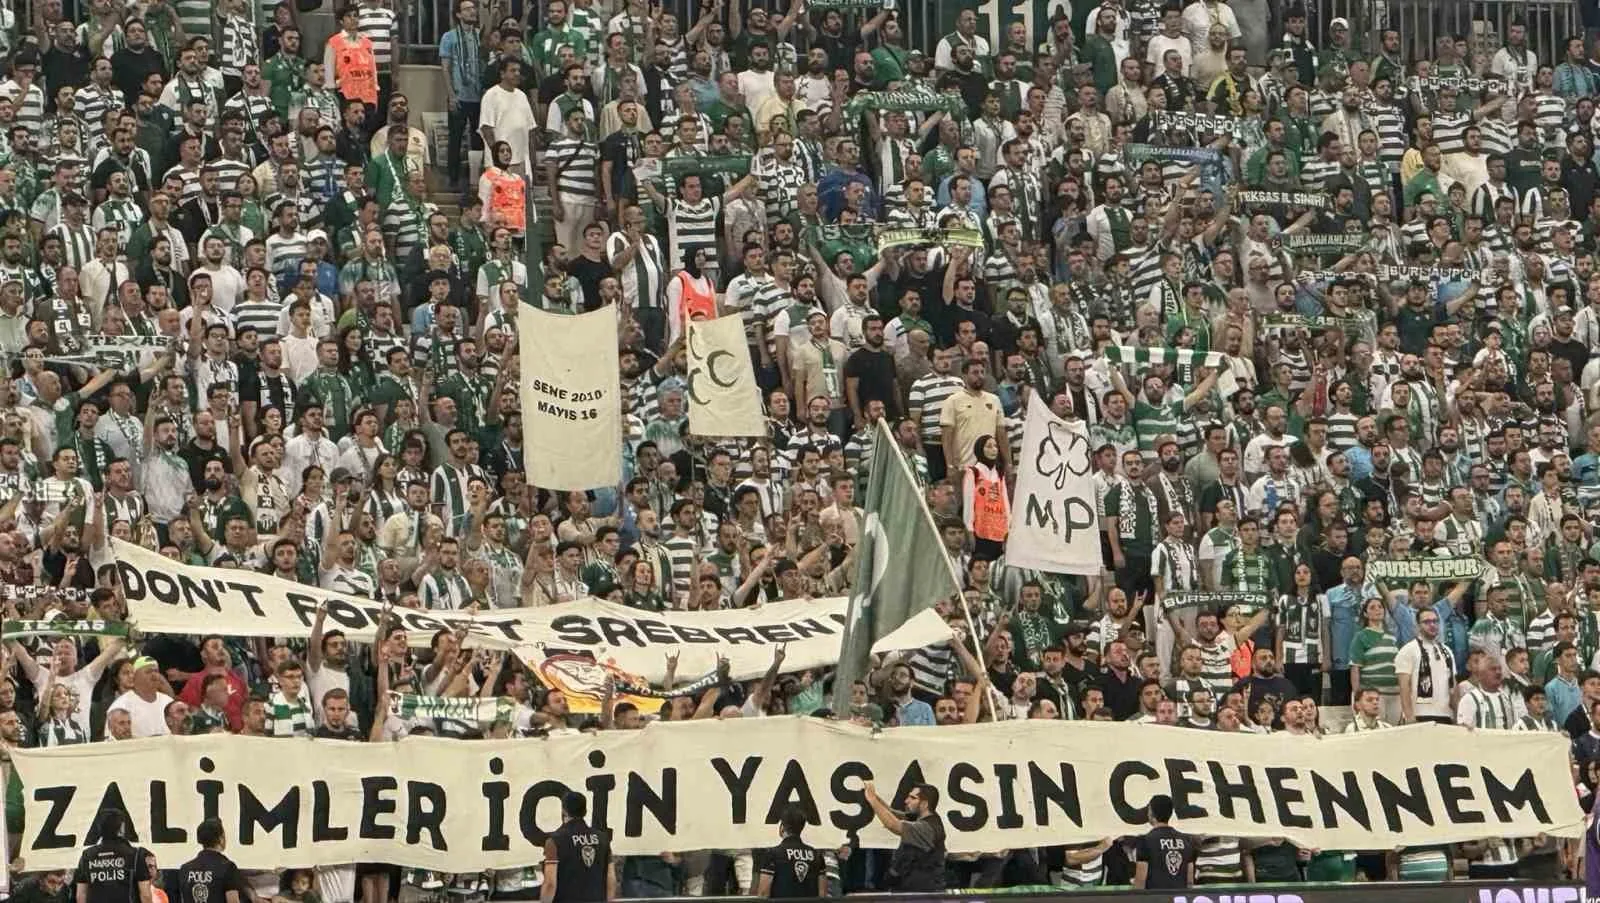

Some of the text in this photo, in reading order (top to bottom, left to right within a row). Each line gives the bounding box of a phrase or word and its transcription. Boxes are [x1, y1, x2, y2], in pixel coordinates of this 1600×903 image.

[533, 379, 602, 403] SENE 2010
[537, 400, 598, 421] MAYIS 16
[1025, 493, 1095, 544] MP
[1375, 558, 1481, 578] BURSASPOR
[116, 559, 846, 648] DON'T FORGET SREBREN
[1163, 593, 1268, 609] BURSASPOR
[31, 756, 448, 851] ZALİMLER
[711, 755, 1083, 848] YAŞASIN
[1108, 757, 1553, 833] CEHENNEM
